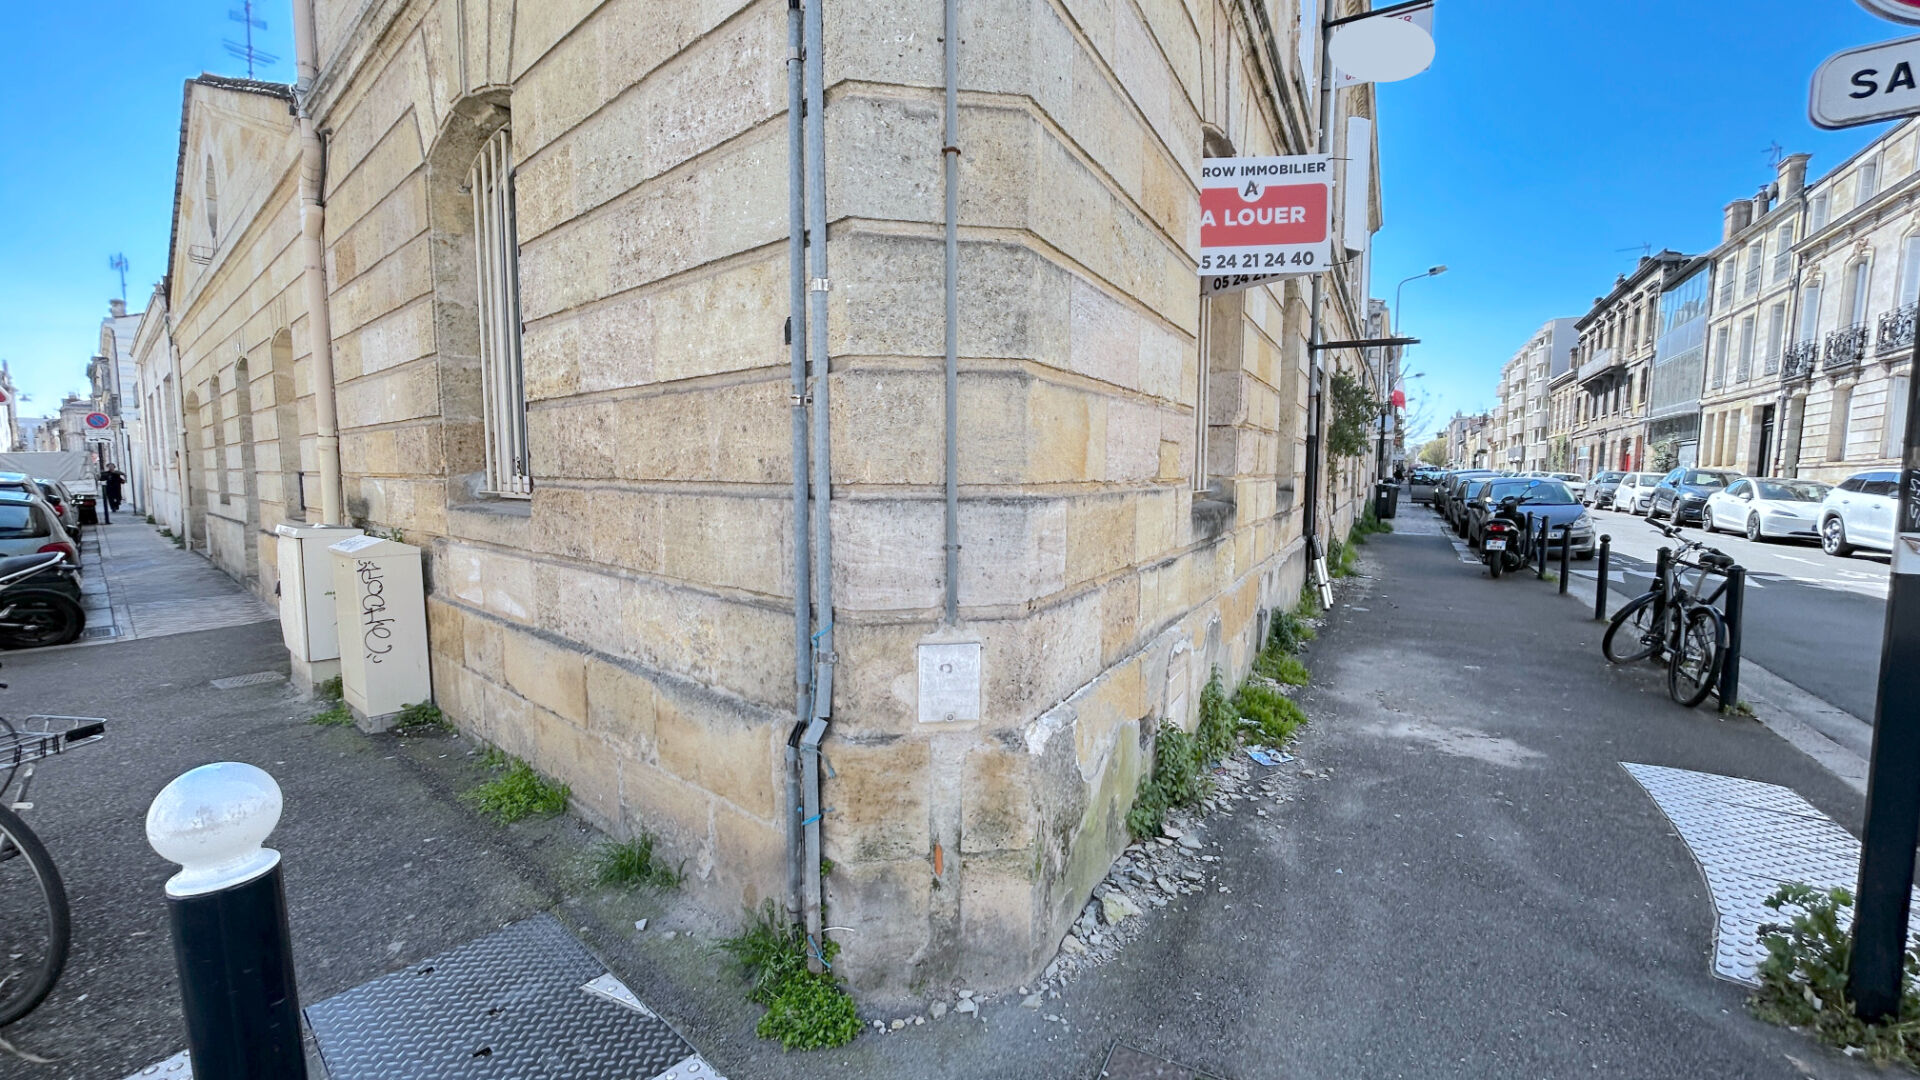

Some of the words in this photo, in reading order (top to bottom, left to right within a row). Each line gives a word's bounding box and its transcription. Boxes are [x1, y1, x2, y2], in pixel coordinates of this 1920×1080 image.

[1202, 166, 1236, 178] ROW
[1240, 162, 1326, 176] IMMOBILIER
[1200, 209, 1217, 228] A
[1224, 206, 1306, 227] LOUER
[1216, 254, 1237, 269] 24
[1242, 253, 1259, 268] 21
[1264, 252, 1286, 267] 24
[1290, 251, 1314, 266] 40
[1213, 275, 1230, 290] 05
